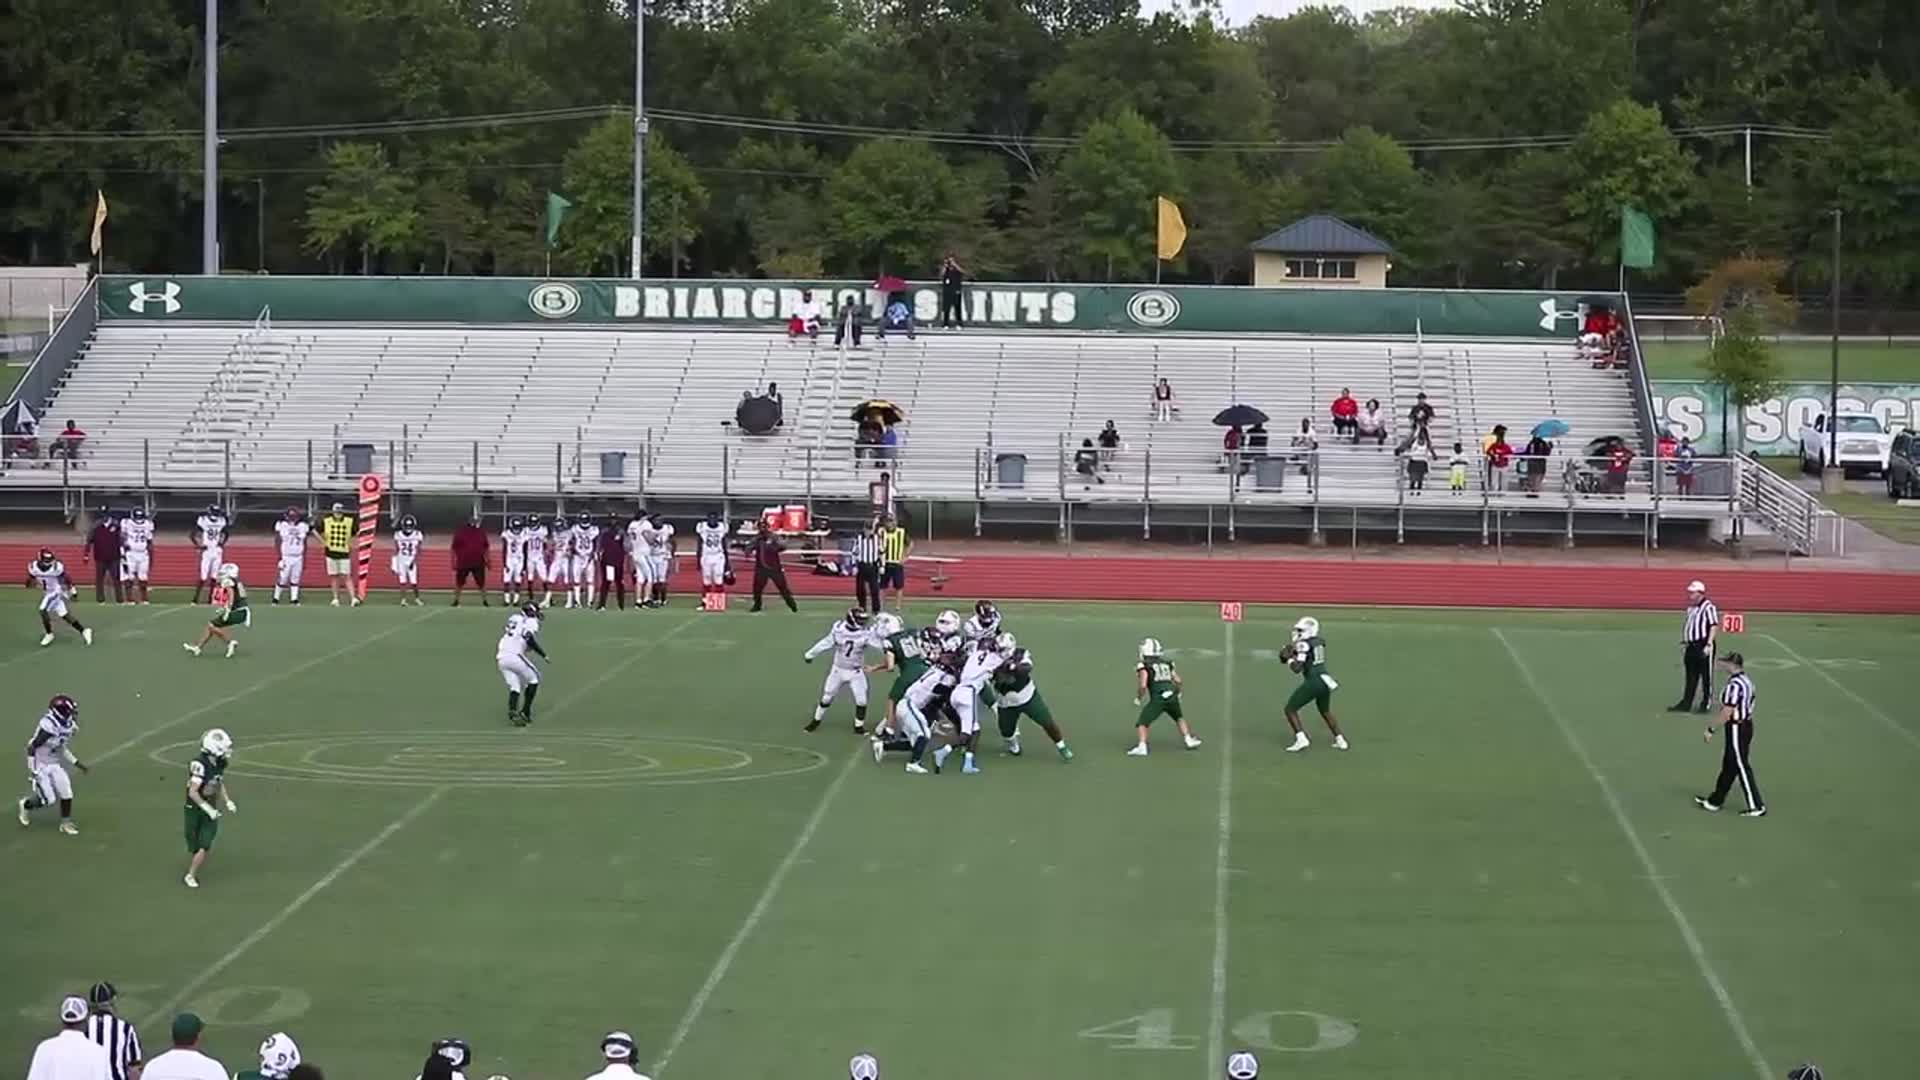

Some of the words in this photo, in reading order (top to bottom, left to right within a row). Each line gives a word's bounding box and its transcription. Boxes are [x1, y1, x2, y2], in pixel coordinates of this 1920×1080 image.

[1223, 604, 1240, 619] 40
[1725, 616, 1741, 632] 30
[845, 640, 855, 658] 7
[977, 652, 988, 666] 9
[1077, 1008, 1358, 1052] 40
